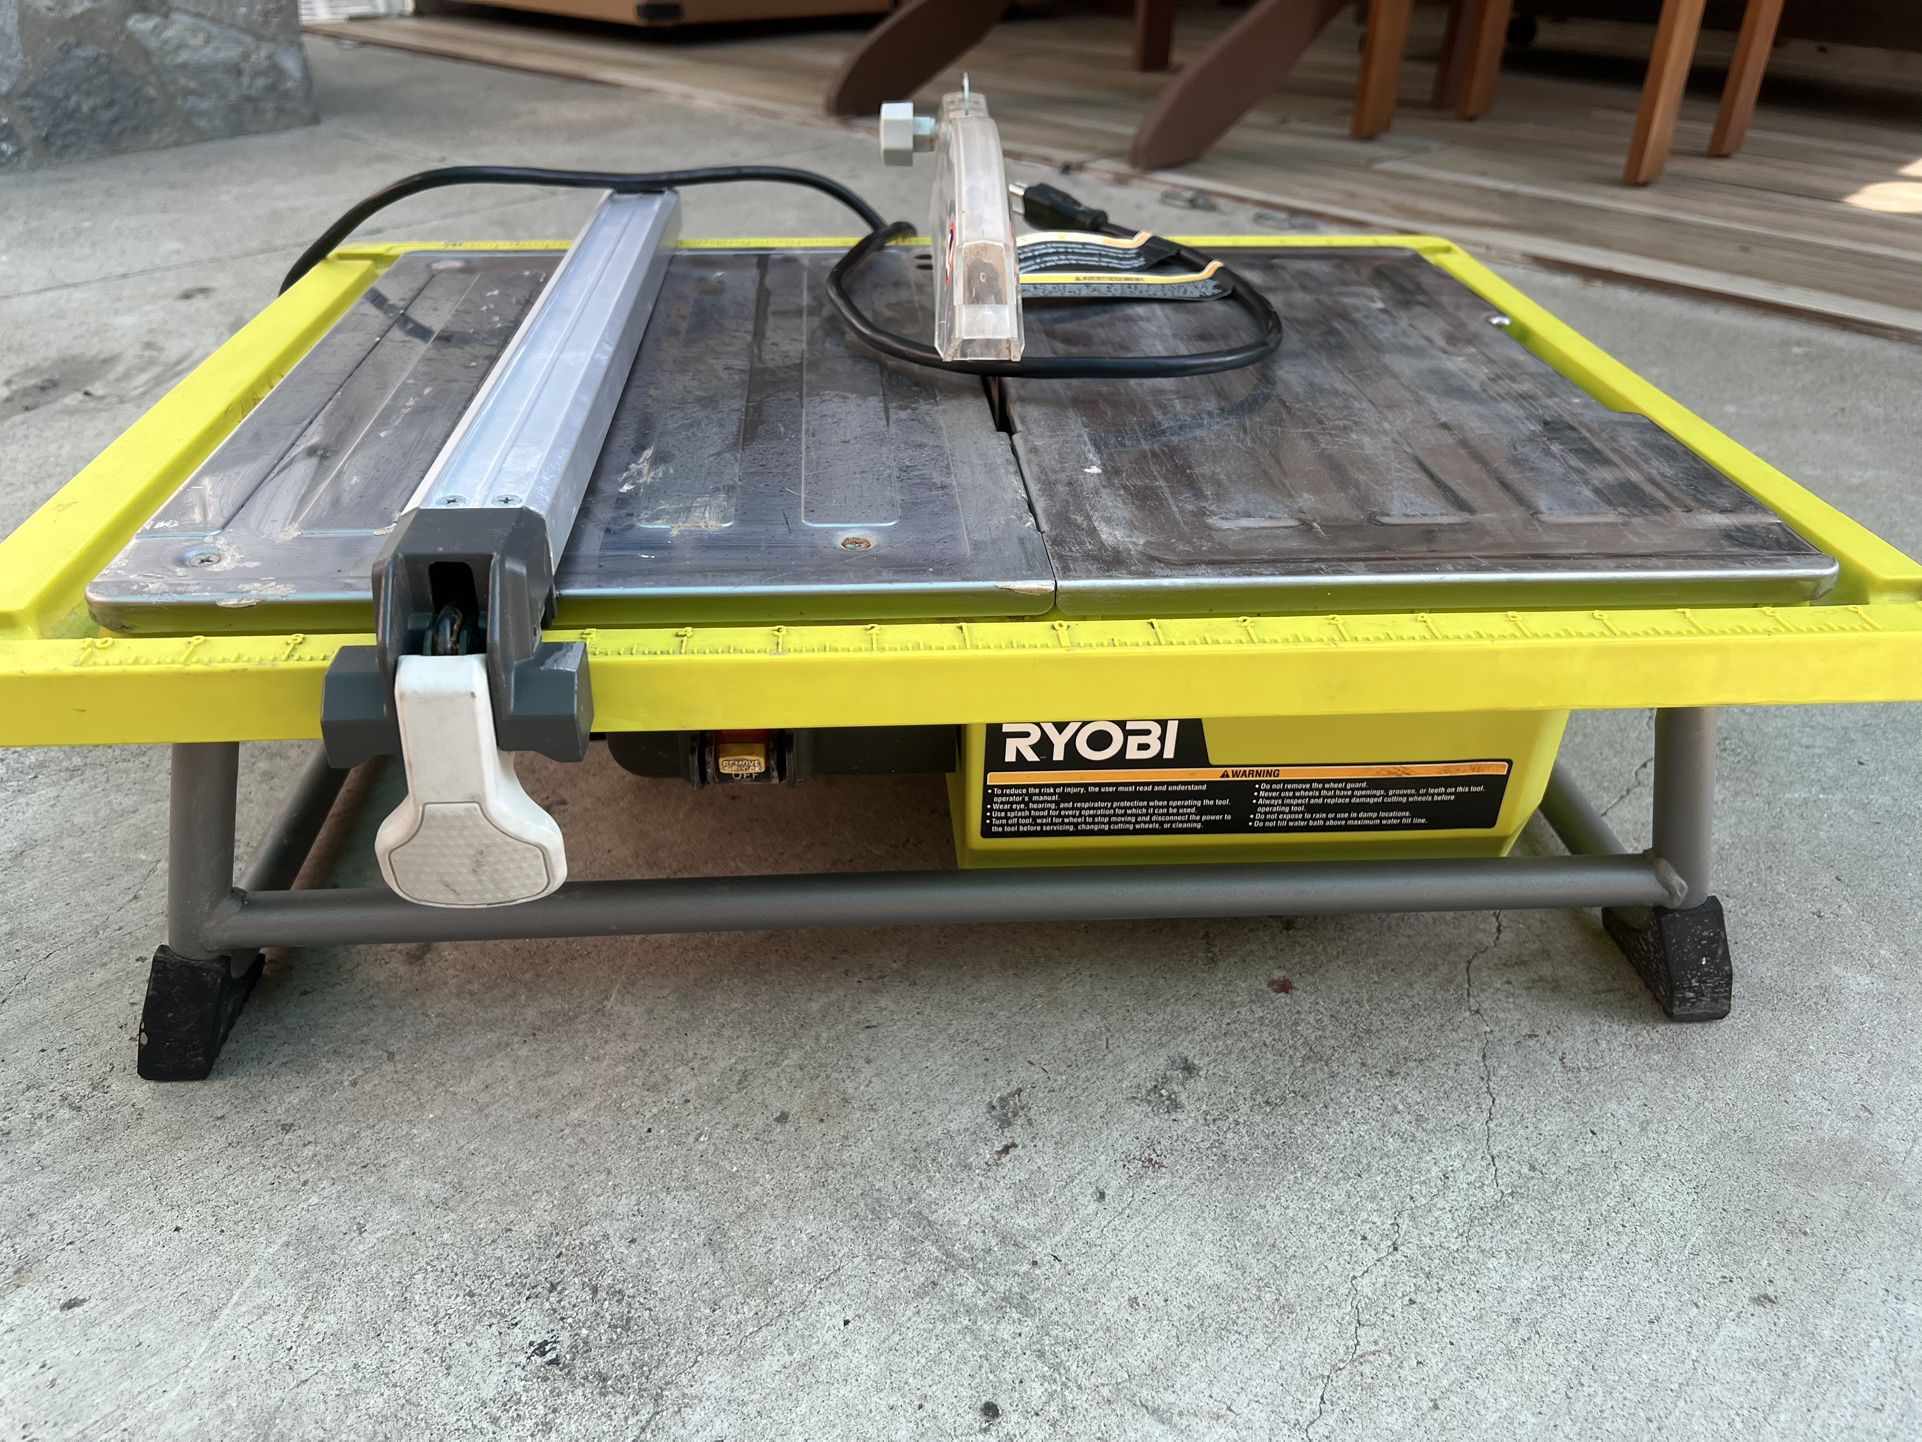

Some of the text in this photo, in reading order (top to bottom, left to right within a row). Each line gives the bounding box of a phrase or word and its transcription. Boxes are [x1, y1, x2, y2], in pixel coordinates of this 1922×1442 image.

[1002, 720, 1179, 762] RYOBI
[1231, 769, 1280, 778] WARNING
[1003, 786, 1026, 794] reduce
[1168, 783, 1206, 791] understand
[1295, 788, 1319, 796] wheels
[993, 794, 1028, 803] operator's
[1257, 797, 1281, 806] Always
[1283, 797, 1308, 806] inspect
[1324, 796, 1349, 805] replace
[1351, 795, 1382, 804] damaged
[1383, 794, 1406, 803] cutting
[1433, 793, 1454, 801] before
[1074, 800, 1111, 809] respiratory
[1113, 800, 1147, 809] protection
[1168, 799, 1201, 808] operating
[1007, 809, 1029, 818] splash
[1081, 808, 1113, 817] operation
[1257, 805, 1289, 813] operating
[1358, 810, 1377, 819] damp
[1094, 815, 1108, 824] stop
[1110, 815, 1135, 824] moving
[1347, 817, 1379, 825] maximum
[1077, 823, 1108, 832] changing
[1110, 823, 1133, 832] cutting
